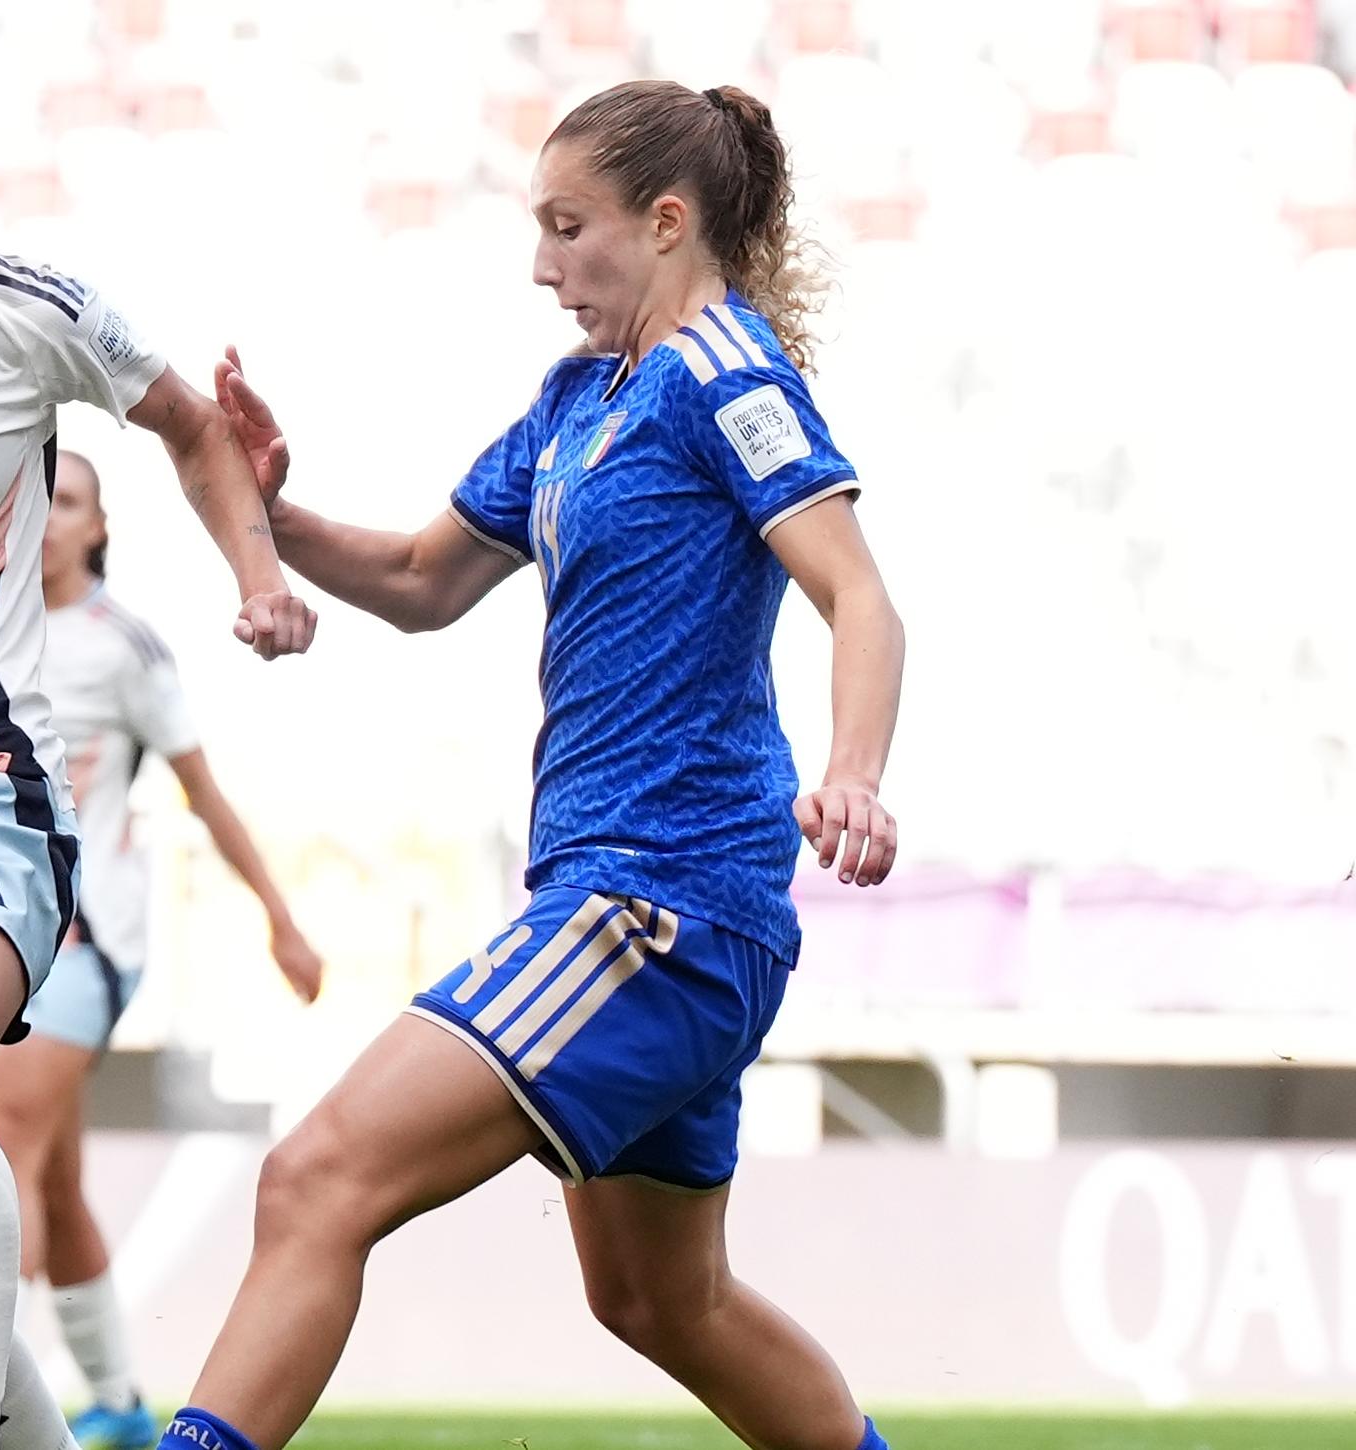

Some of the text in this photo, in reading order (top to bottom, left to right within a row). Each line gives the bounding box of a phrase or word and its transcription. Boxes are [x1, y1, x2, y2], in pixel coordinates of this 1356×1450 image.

[732, 400, 776, 428] FOOTBALL
[739, 410, 784, 441] UNITES
[748, 441, 765, 456] the
